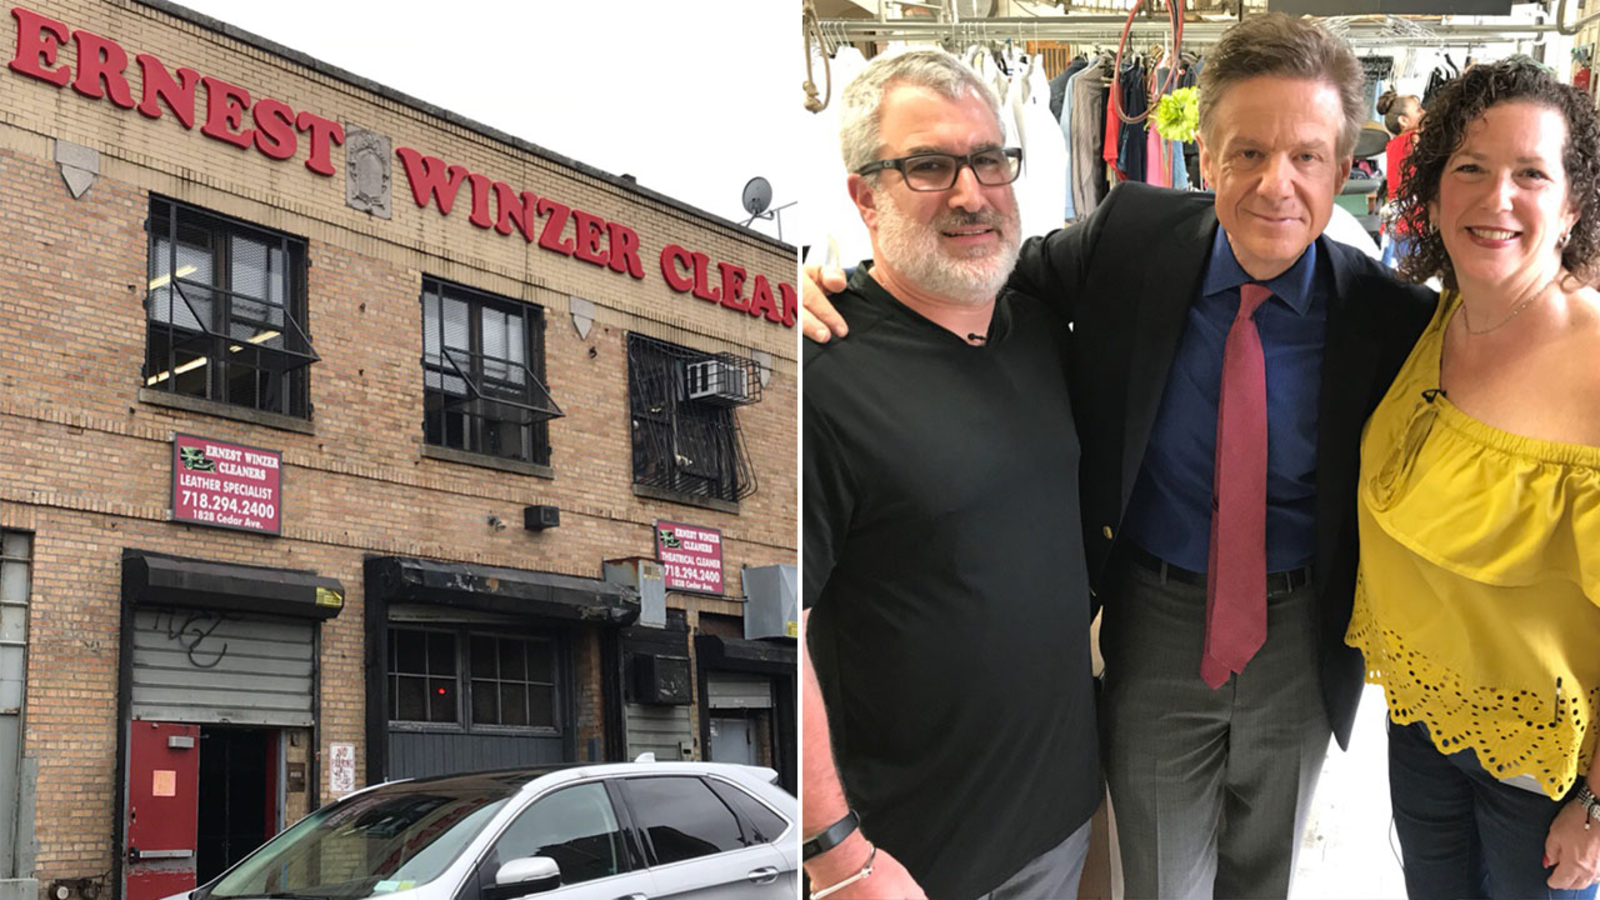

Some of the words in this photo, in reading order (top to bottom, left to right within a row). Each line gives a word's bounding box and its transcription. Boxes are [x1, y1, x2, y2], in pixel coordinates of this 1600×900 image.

[8, 7, 345, 177] ERNEST
[395, 147, 645, 280] WINZER
[205, 445, 242, 462] ERNEST
[244, 452, 280, 469] WINZER
[218, 462, 267, 480] CLEANERS
[180, 473, 221, 491] LEATHER
[223, 481, 273, 500] SPECIALIST
[182, 490, 275, 519] 718.294.2400
[193, 509, 215, 522] 1828
[216, 514, 242, 526] Cedar
[244, 518, 264, 529] Ave.
[661, 551, 695, 565] THEATRICAL
[695, 556, 721, 569] CLEANER
[664, 564, 720, 583] 718.294.2400
